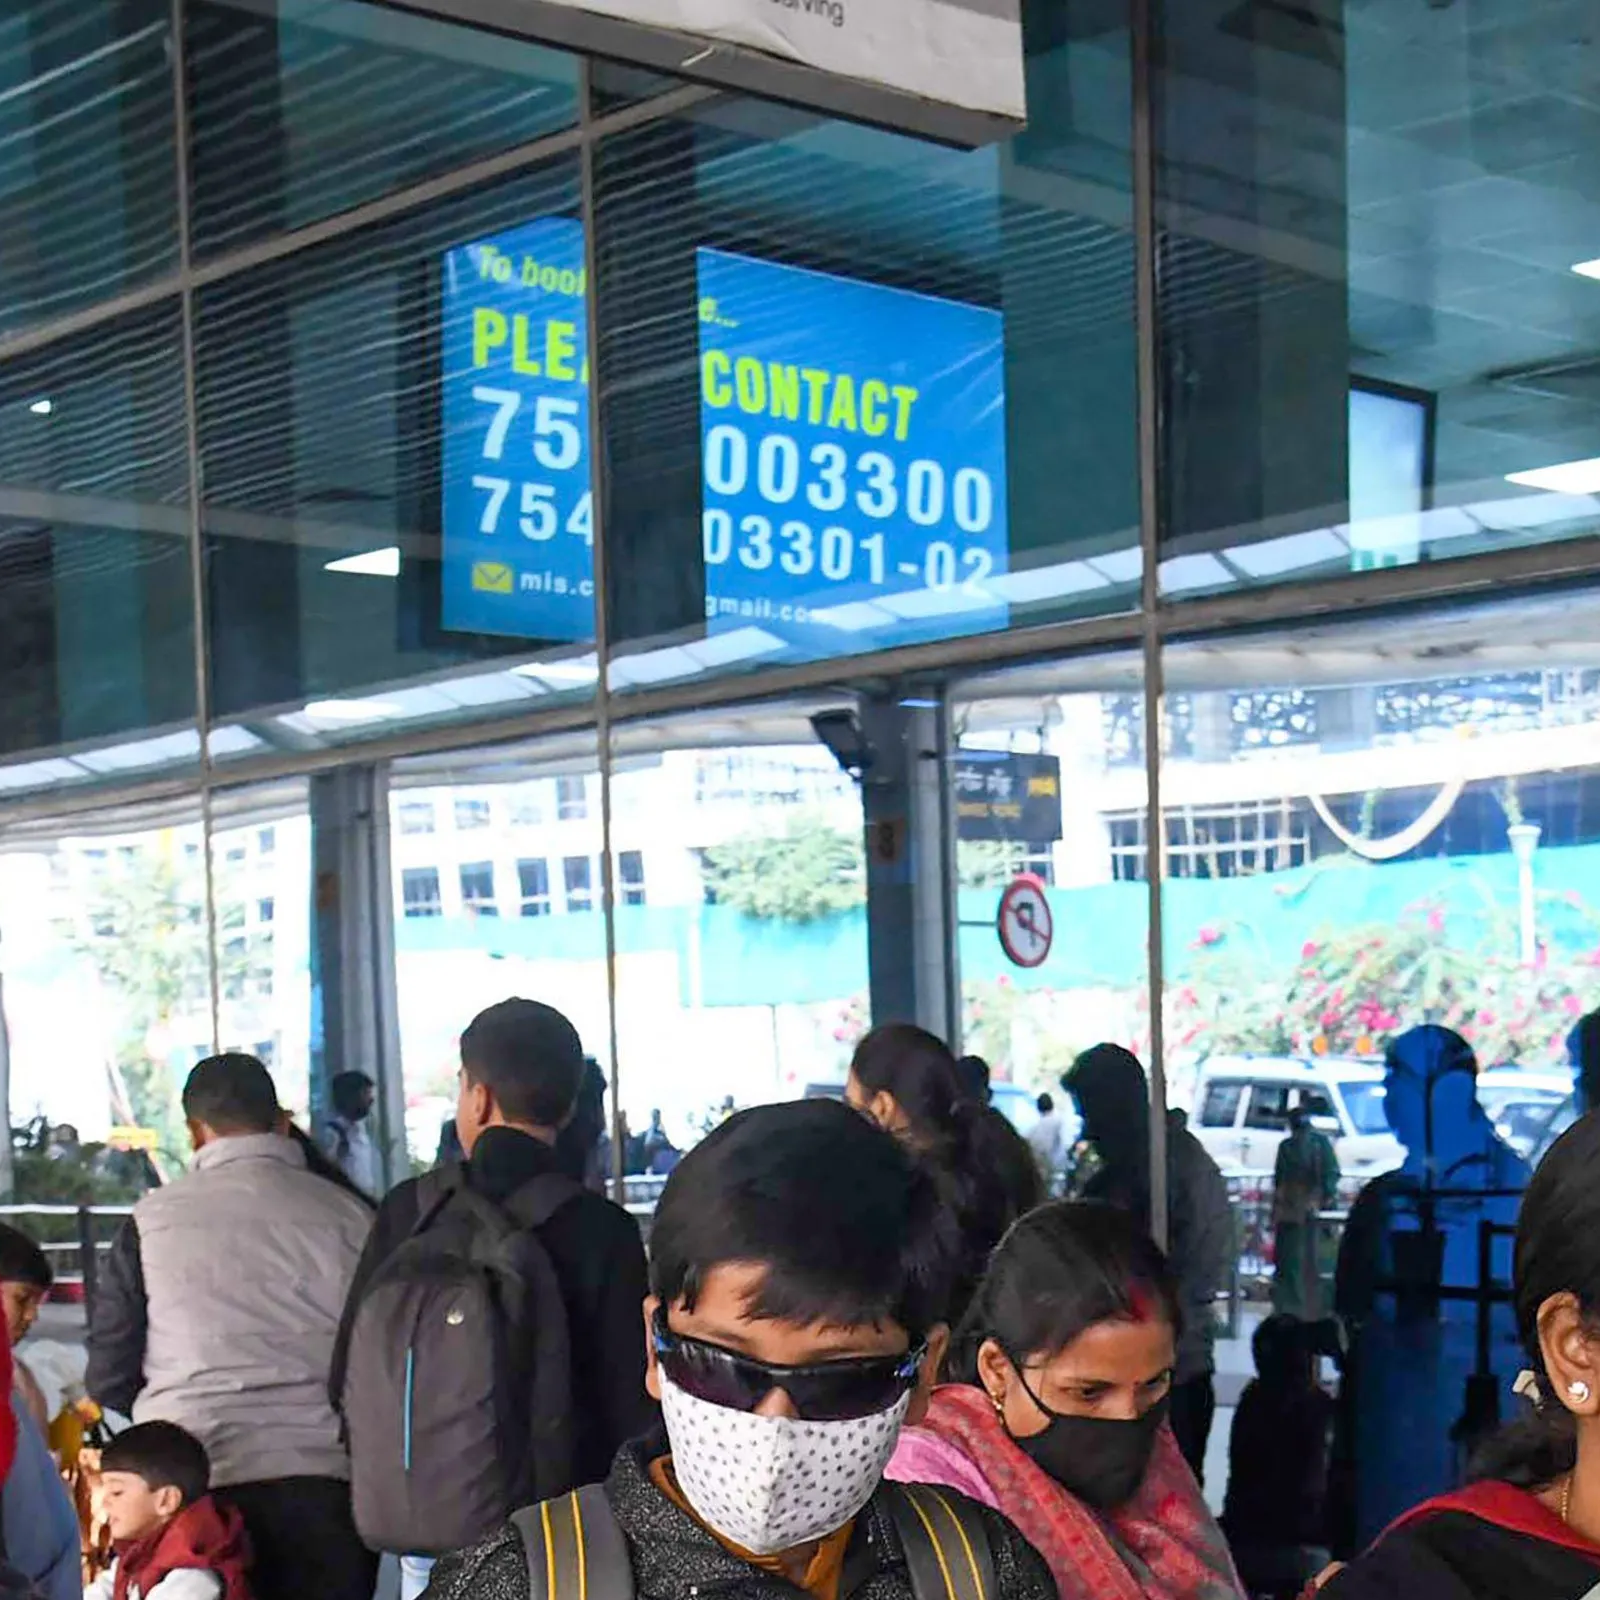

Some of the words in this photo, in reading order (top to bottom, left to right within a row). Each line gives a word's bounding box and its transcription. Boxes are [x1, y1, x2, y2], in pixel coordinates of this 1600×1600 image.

[479, 245, 512, 284] To
[473, 307, 589, 384] PLE
[702, 350, 918, 441] CONTACT
[472, 386, 581, 470] 75
[704, 425, 992, 532] 003300
[472, 475, 594, 546] 754
[703, 508, 993, 599] 03301-02
[704, 595, 816, 625] gmail.co
